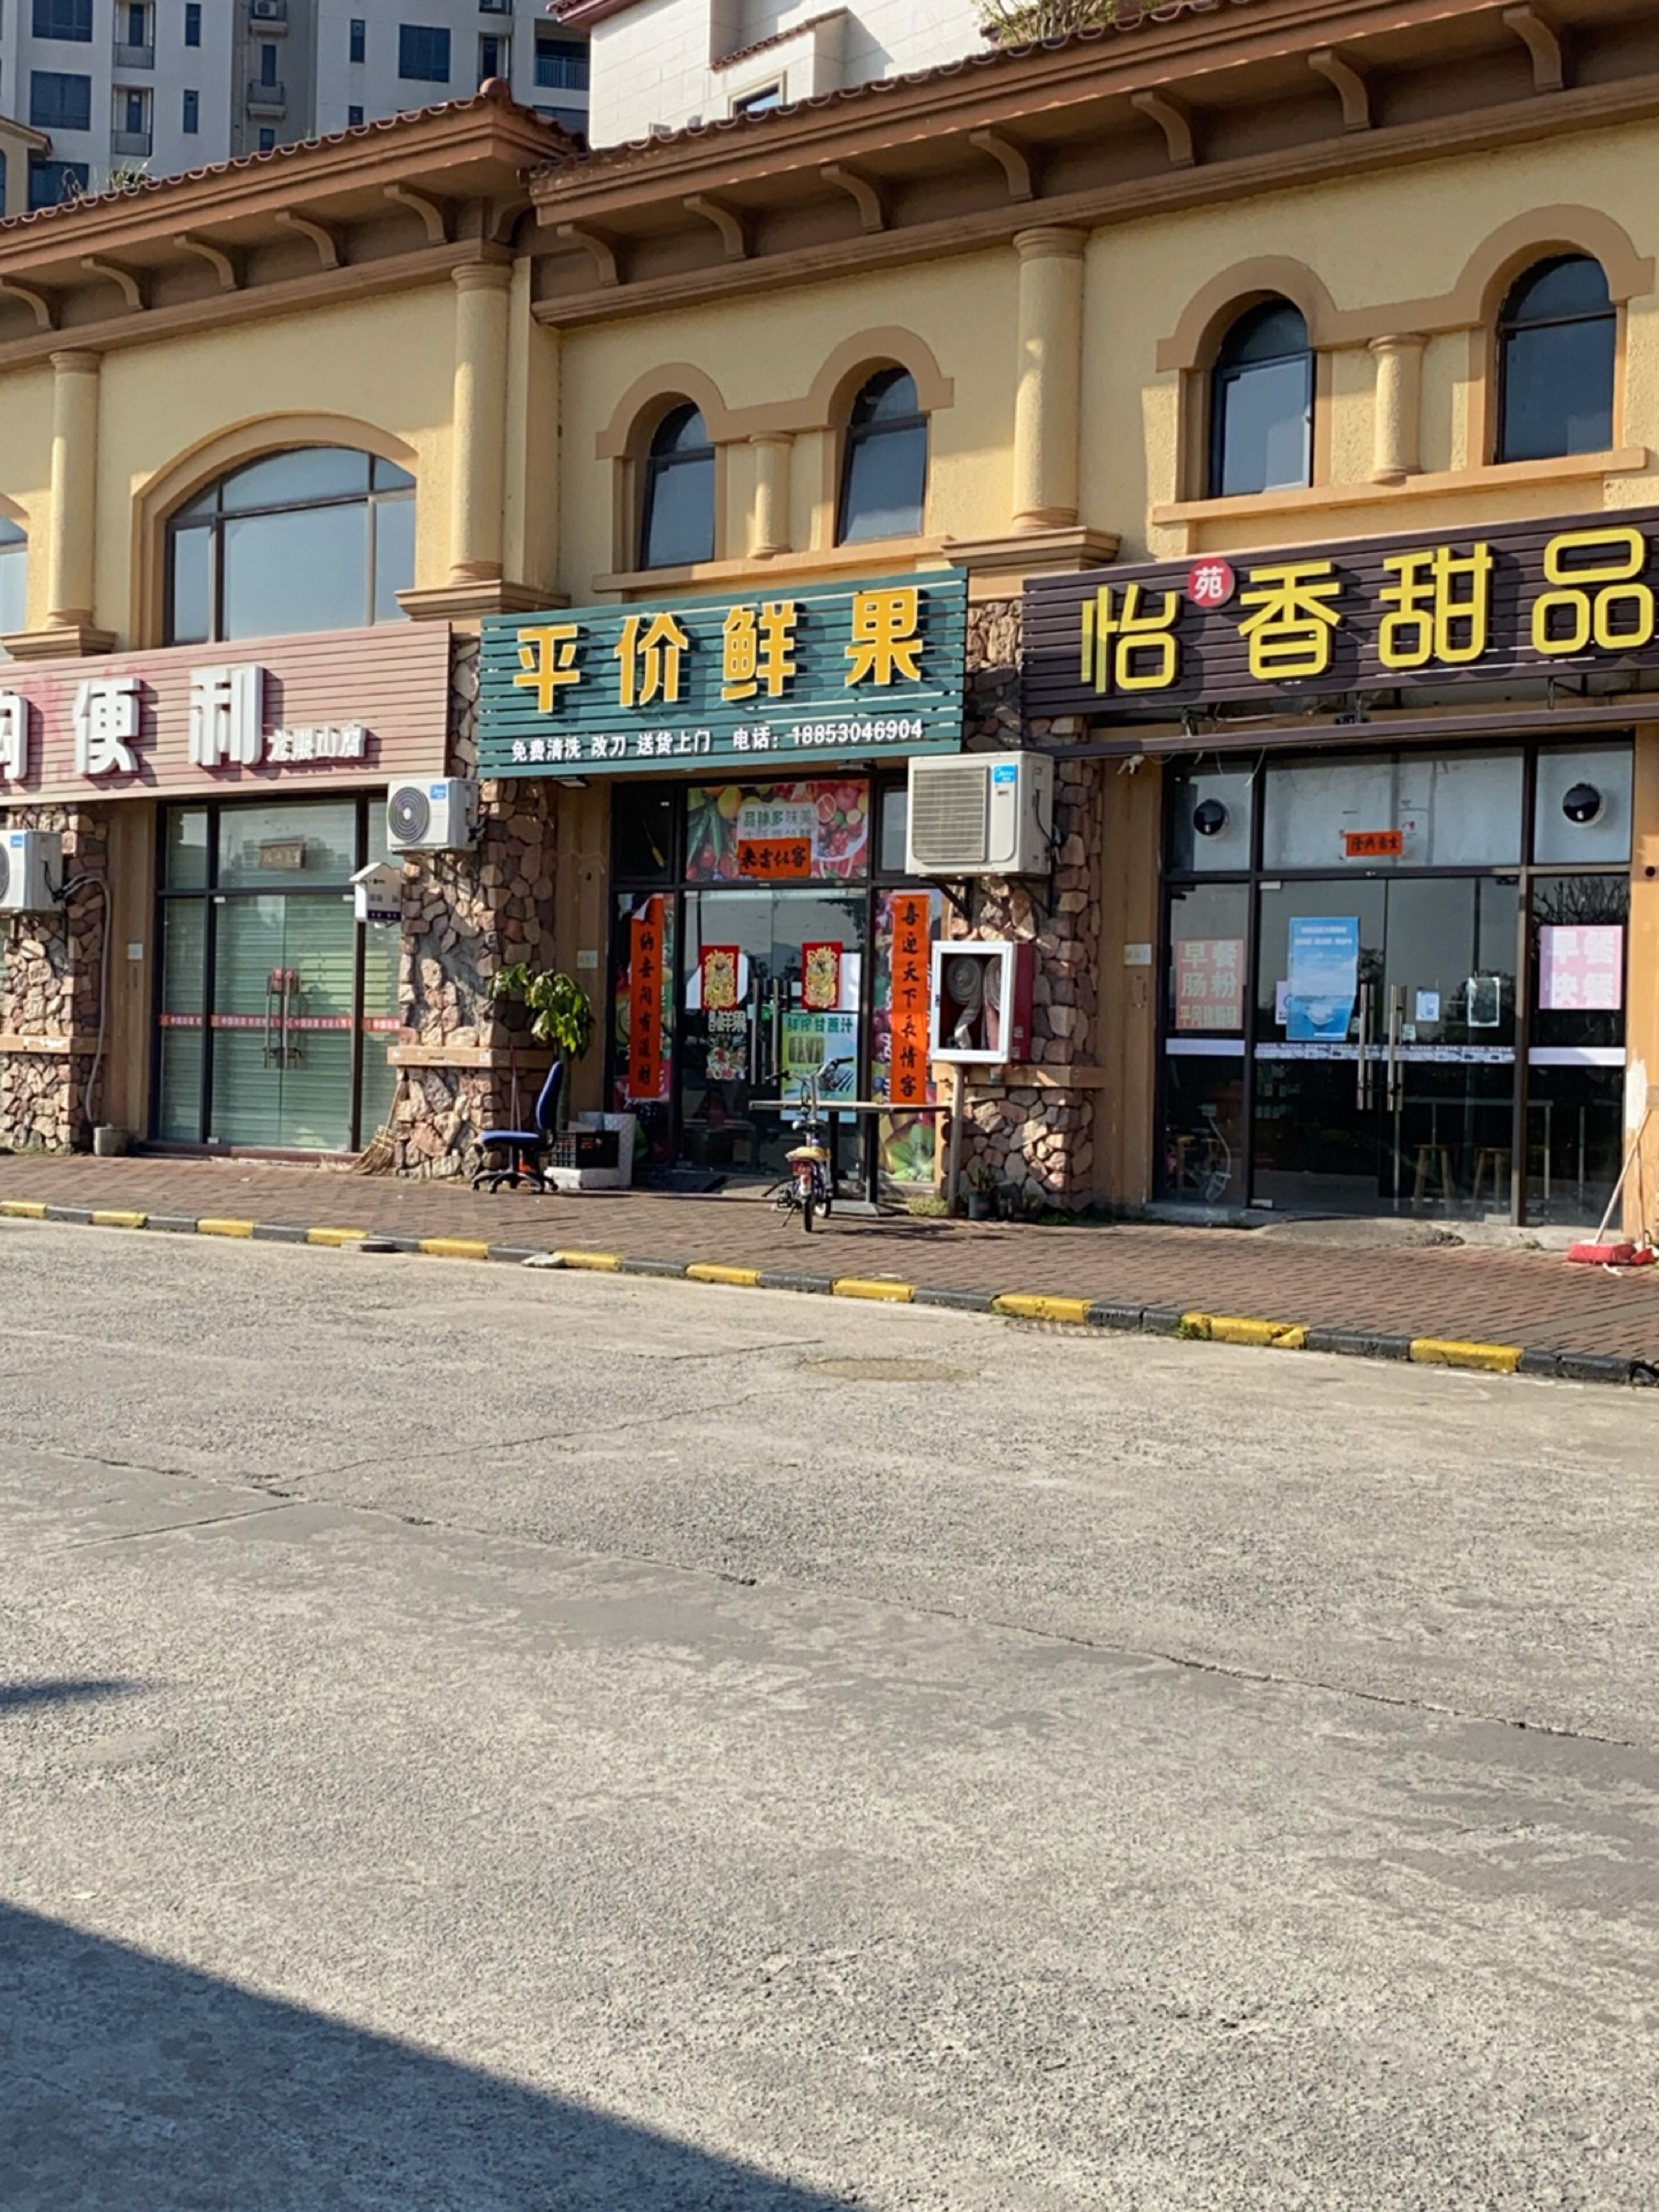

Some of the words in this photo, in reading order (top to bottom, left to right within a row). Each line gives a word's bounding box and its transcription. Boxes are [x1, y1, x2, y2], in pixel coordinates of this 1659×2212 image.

[1194, 566, 1226, 600] 苑
[513, 588, 924, 714] 平价鲜果
[511, 737, 581, 762] 免费清洗
[591, 735, 627, 758] 改刀
[637, 728, 710, 756] 送货上门
[792, 718, 923, 746] 18853046904
